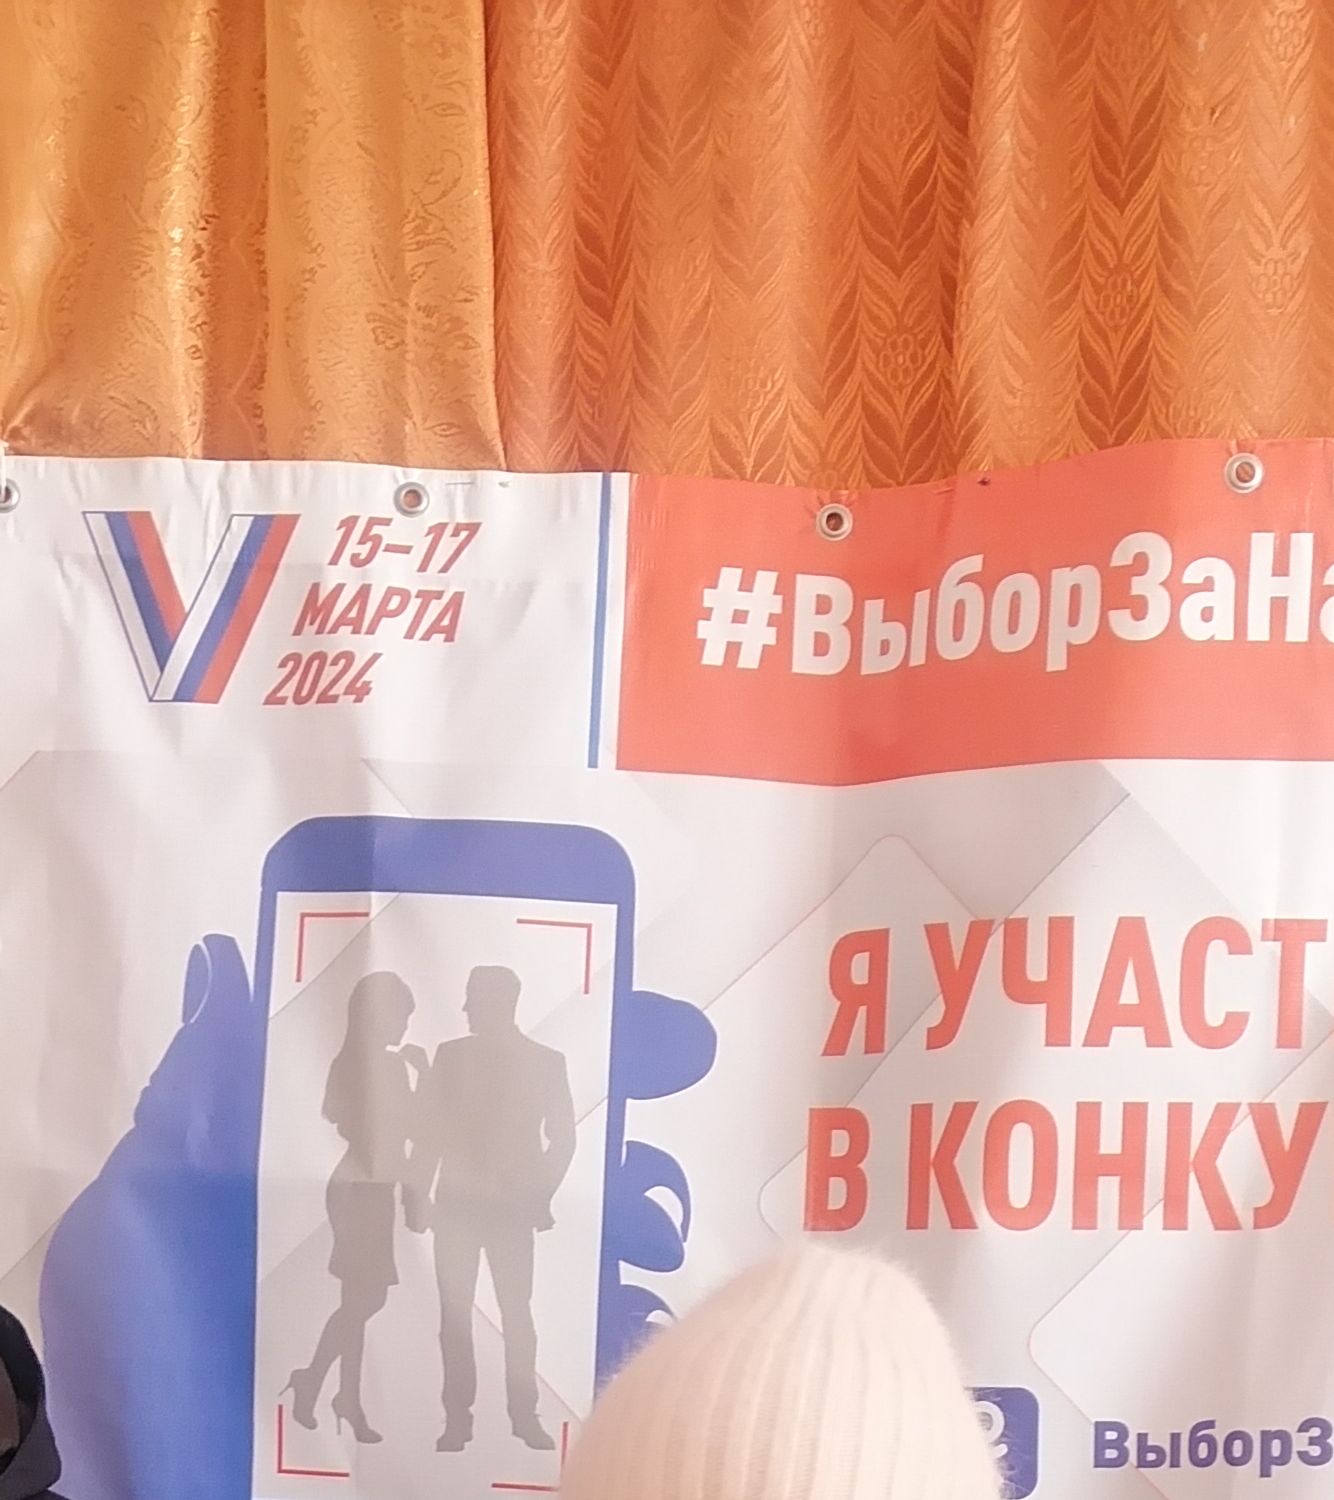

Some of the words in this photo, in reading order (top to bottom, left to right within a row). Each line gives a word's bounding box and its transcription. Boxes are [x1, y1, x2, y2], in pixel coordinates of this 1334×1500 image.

[291, 582, 466, 644] МАРТА
[262, 650, 384, 706] 2024
[820, 926, 891, 1057] Я
[803, 1106, 871, 1232] В
